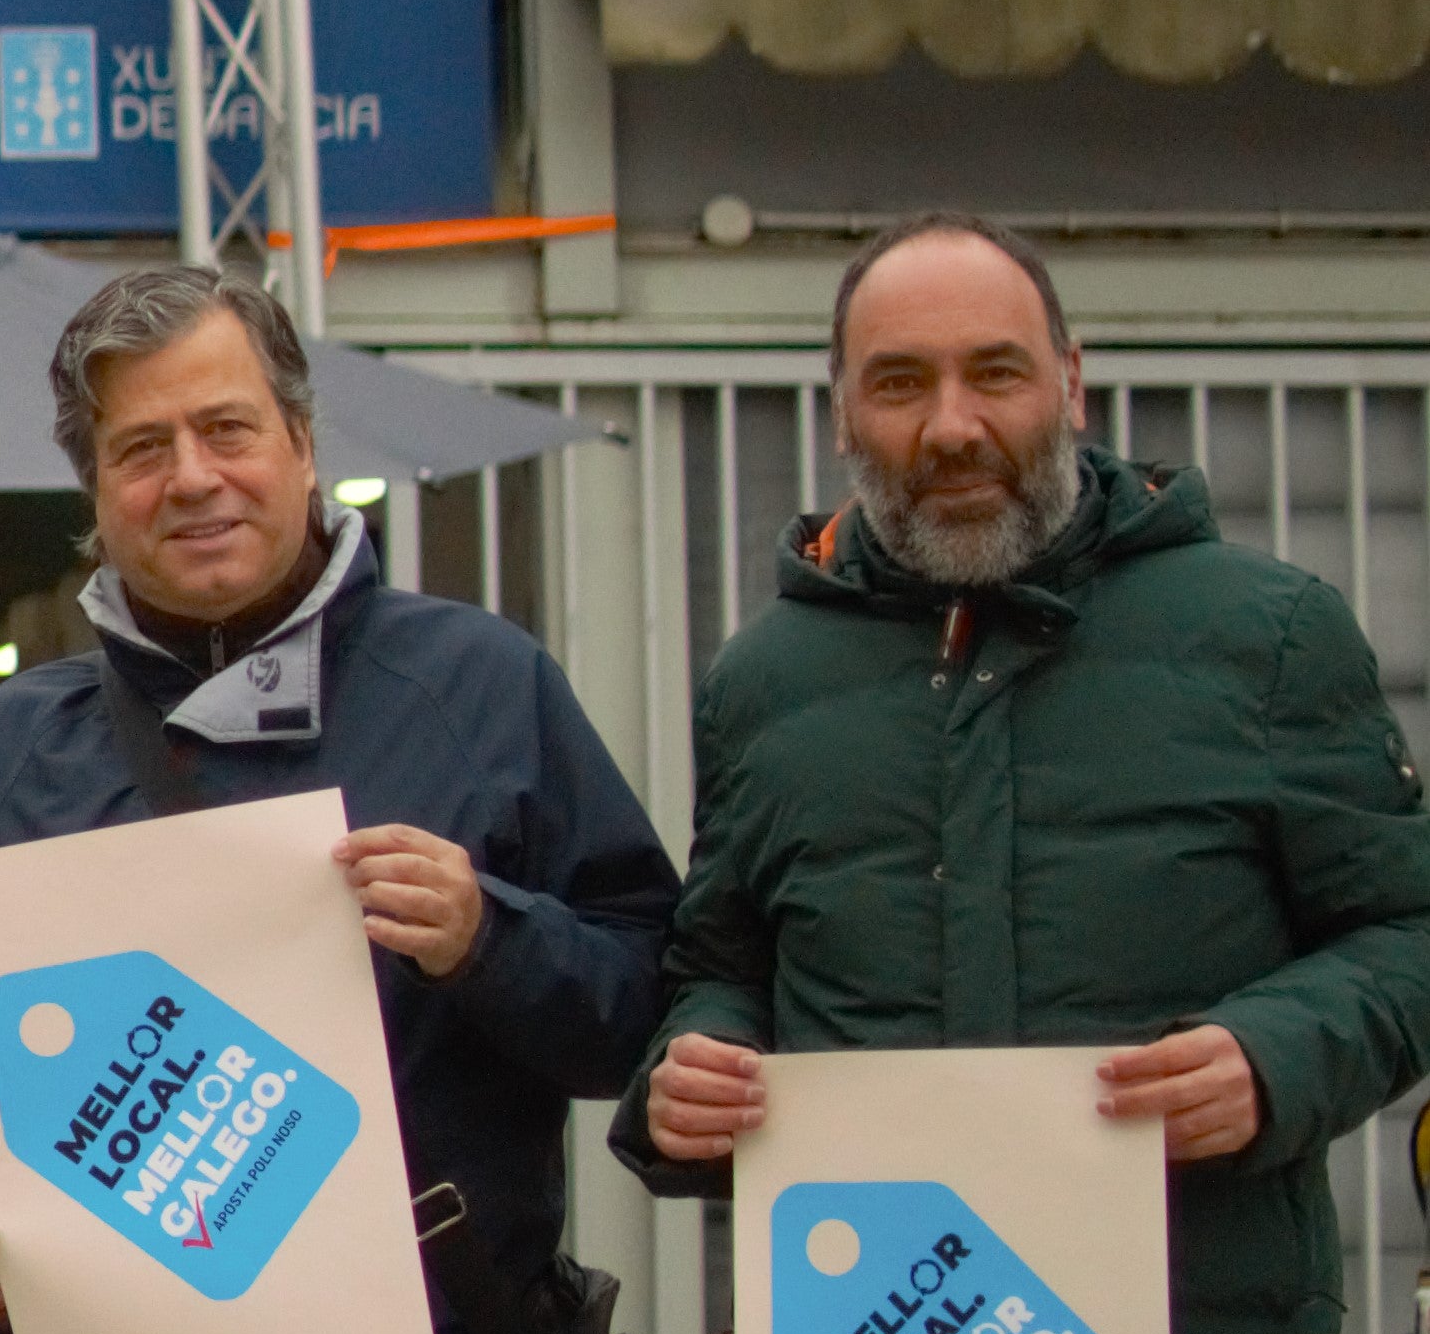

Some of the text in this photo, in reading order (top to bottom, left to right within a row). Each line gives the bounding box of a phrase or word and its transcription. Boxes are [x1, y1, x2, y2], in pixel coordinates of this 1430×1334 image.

[53, 995, 186, 1165] MELLOR
[88, 1049, 207, 1191] LOCAL.
[121, 1045, 257, 1217] MELLOR
[213, 1108, 303, 1233] APOSTA POLO NOSO
